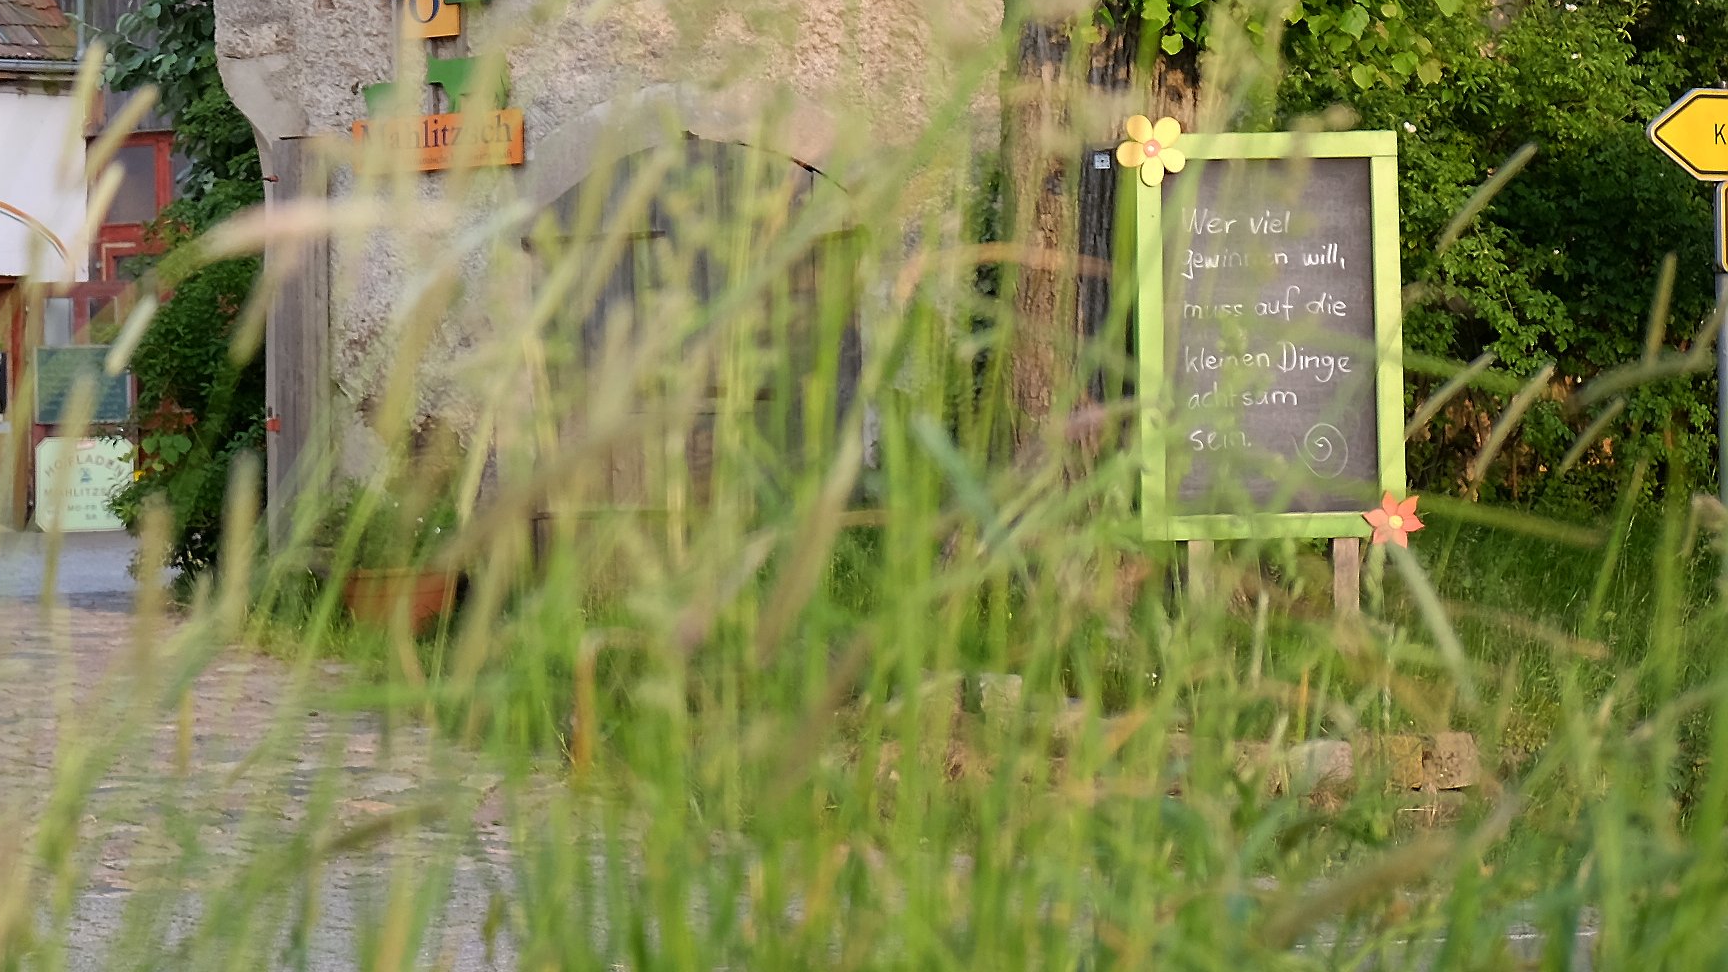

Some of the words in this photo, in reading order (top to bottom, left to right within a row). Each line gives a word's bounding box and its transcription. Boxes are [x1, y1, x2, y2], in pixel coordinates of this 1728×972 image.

[1181, 207, 1237, 235] Wer
[1250, 210, 1291, 234] viel
[1303, 242, 1346, 270] will,
[1255, 285, 1300, 321] auf
[1306, 292, 1346, 317] die
[1185, 346, 1270, 373] kleinen
[1276, 341, 1352, 383] Dinge
